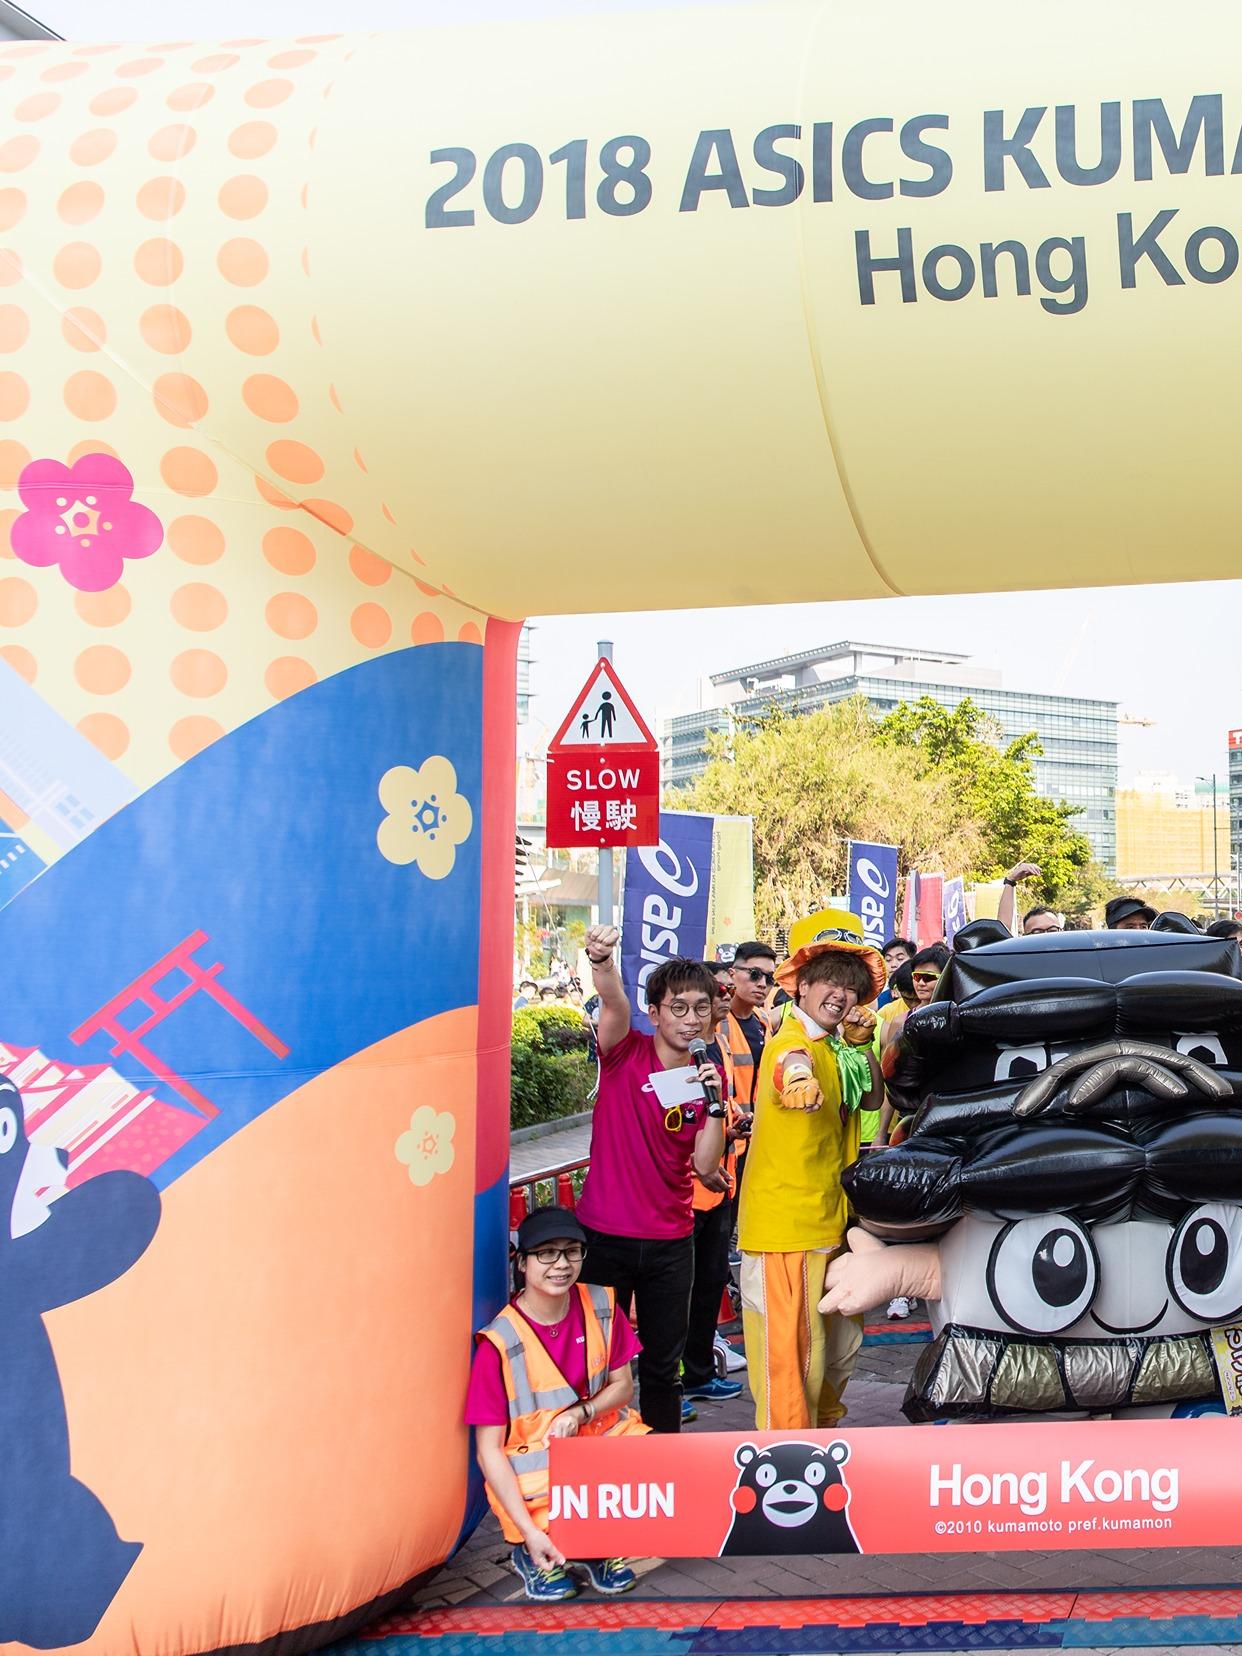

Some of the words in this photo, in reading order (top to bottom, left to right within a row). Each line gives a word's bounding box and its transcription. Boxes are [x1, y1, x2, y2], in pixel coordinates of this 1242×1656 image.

[425, 135, 653, 229] 2018
[678, 114, 954, 213] ASICS
[854, 227, 1089, 316] Hong
[566, 768, 640, 791] SLOW
[570, 798, 638, 831] 慢駛
[598, 1481, 675, 1520] RUN
[928, 1463, 1048, 1516] Hong
[1058, 1459, 1183, 1512] Kong
[987, 1517, 1063, 1534] kumamoto
